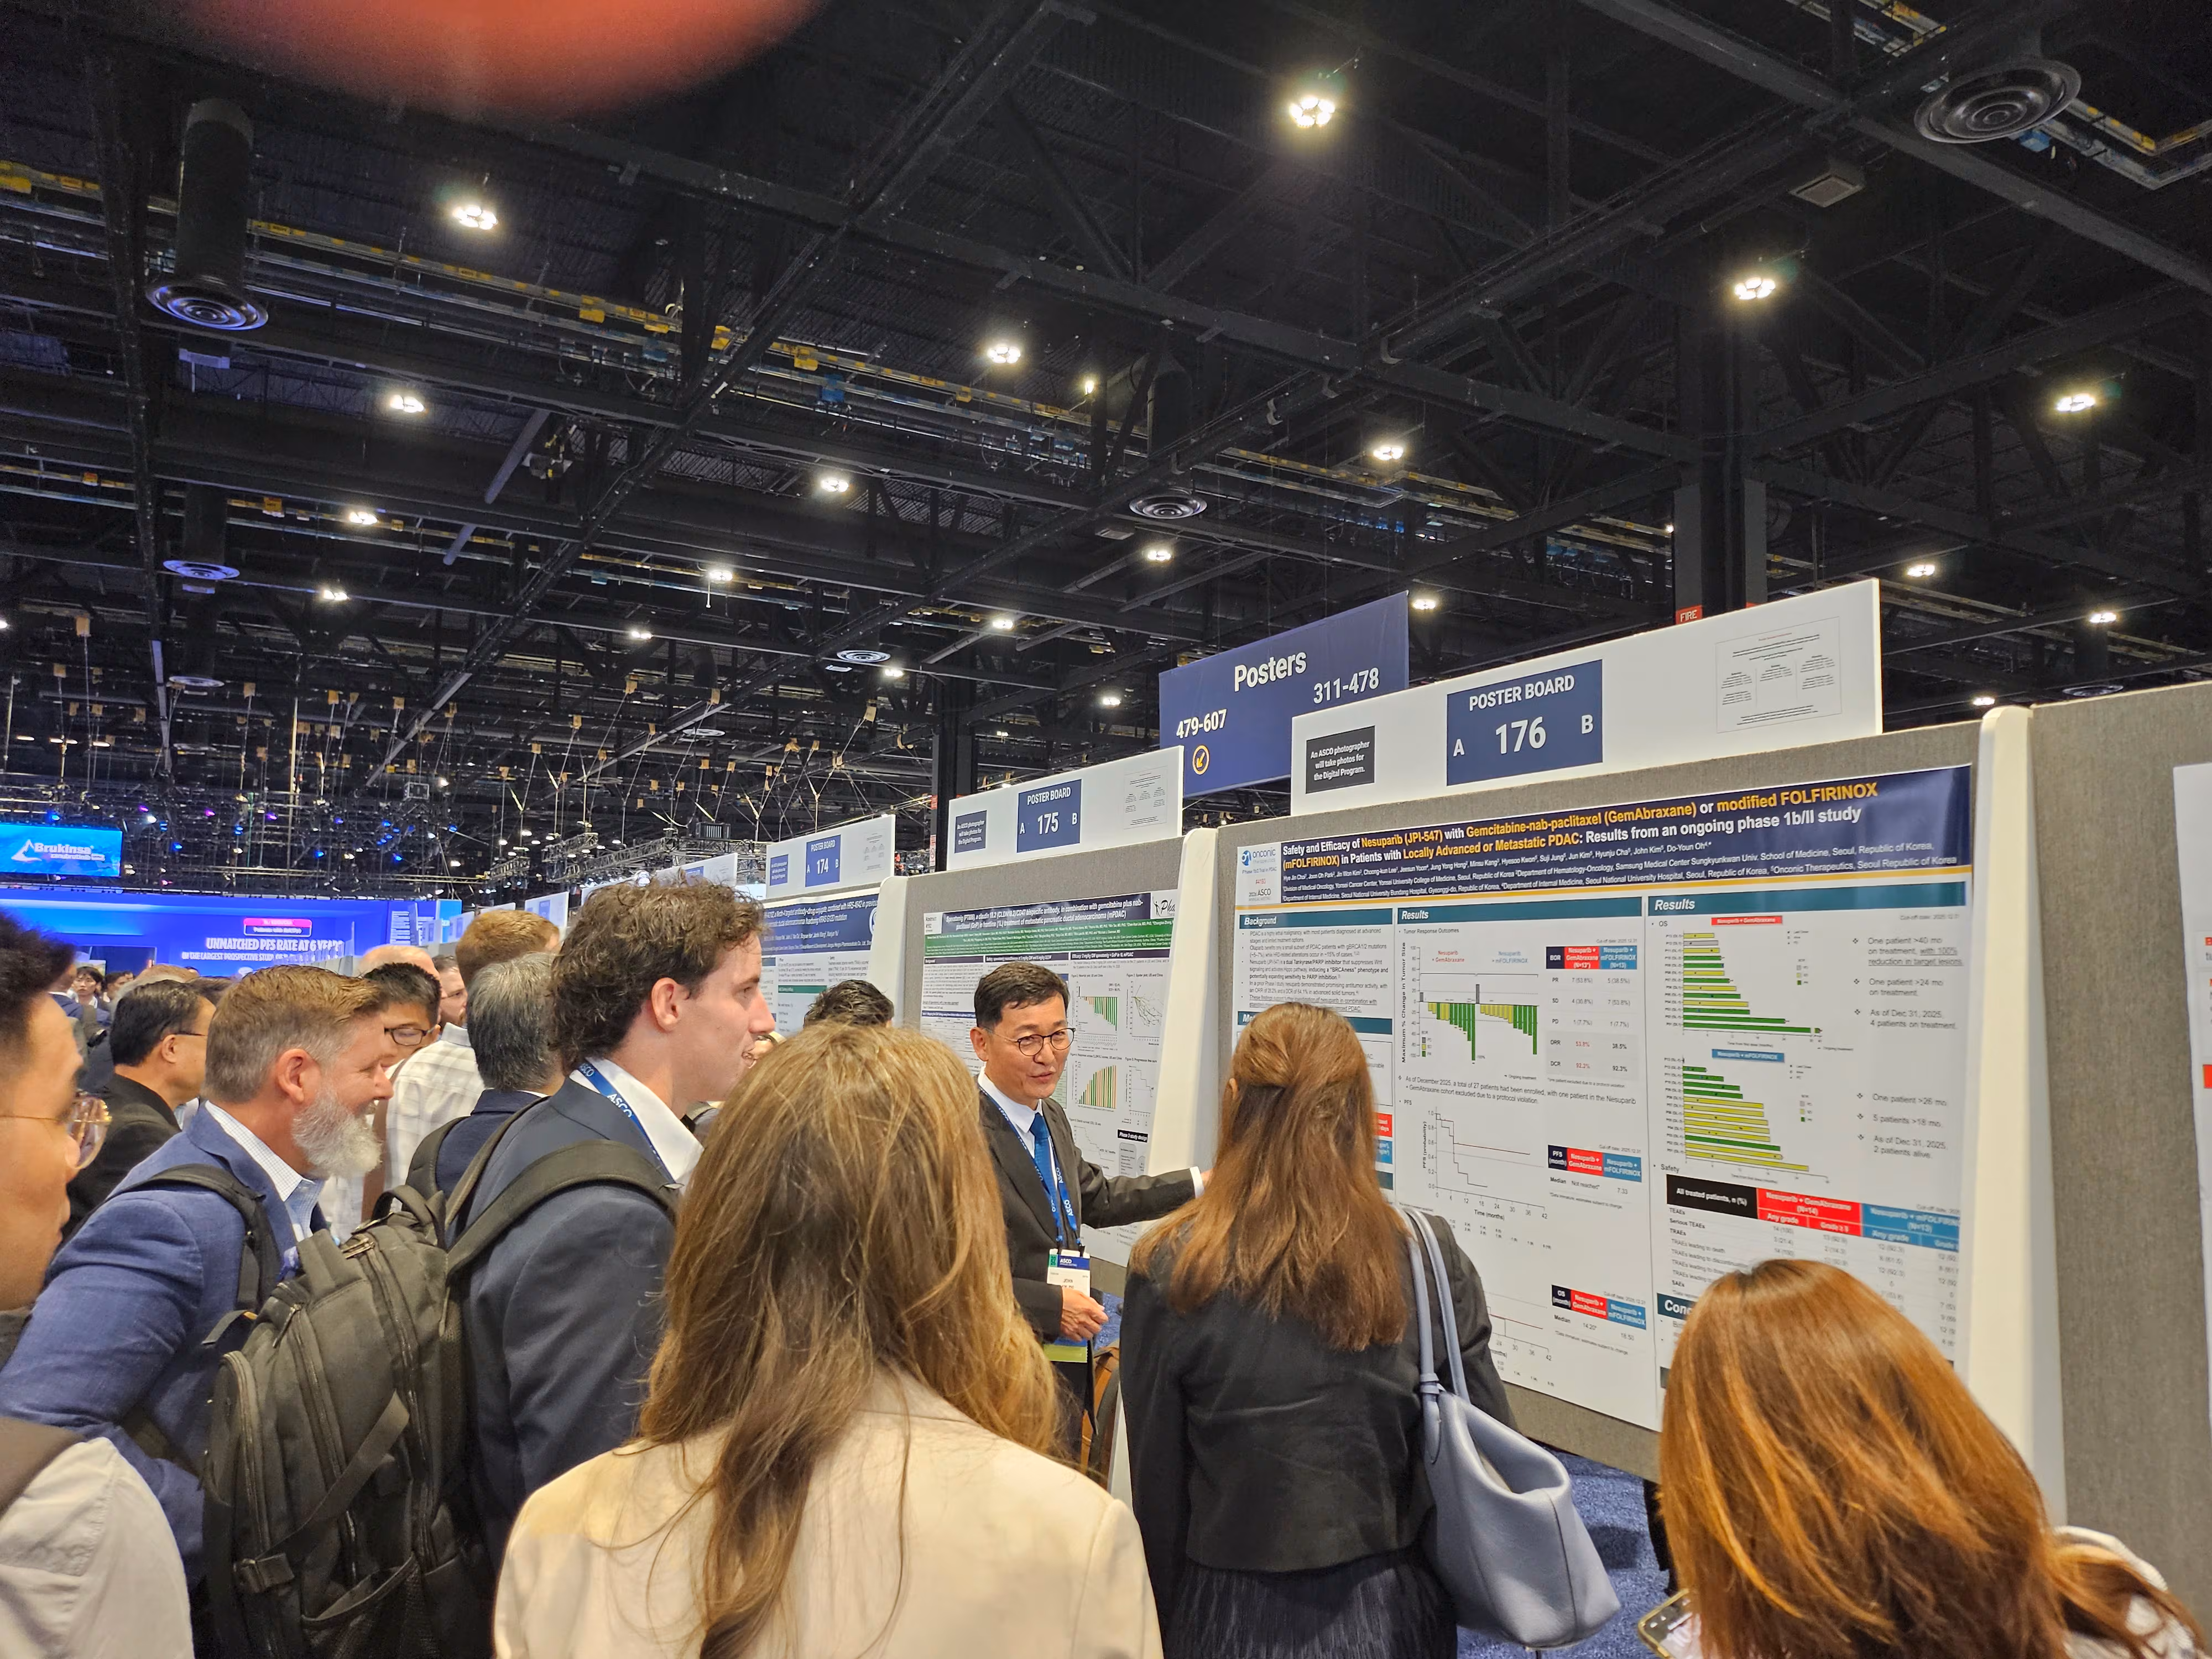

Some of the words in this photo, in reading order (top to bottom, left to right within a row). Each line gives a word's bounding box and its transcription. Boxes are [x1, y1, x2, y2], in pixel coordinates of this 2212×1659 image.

[1681, 609, 1697, 622] FIRE
[1234, 652, 1306, 692] Posters
[1313, 667, 1379, 703] 311-478
[1470, 686, 1522, 711] POSTER
[1525, 675, 1574, 699] BOARD
[1176, 709, 1227, 739] 479-607
[1453, 739, 1464, 757] A
[1496, 717, 1546, 754] 176
[1582, 714, 1593, 734] B
[1319, 748, 1333, 757] ASCO
[1334, 741, 1370, 755] photographer
[1315, 760, 1324, 769] will
[1337, 756, 1355, 766] photos
[1323, 769, 1339, 780] Digital
[1340, 766, 1365, 776] Program.
[1027, 792, 1050, 805] POSTER
[1051, 787, 1071, 800] BOARD
[1020, 822, 1025, 834] A
[1038, 812, 1059, 834] 175
[1072, 813, 1077, 825] B
[1283, 845, 1305, 856] Safety
[1306, 844, 1319, 853] and
[1321, 840, 1350, 852] Efficacy
[1352, 838, 1360, 848] of
[1361, 834, 1402, 848] Nesuparib
[1405, 830, 1443, 846] (JPI-547)
[1444, 828, 1464, 839] with
[1466, 812, 1601, 838] Gemcitabine-nab-paclitaxel
[1604, 801, 1697, 826] (GemAbraxane)
[1700, 804, 1714, 813] or
[1717, 794, 1776, 812] modified
[1780, 782, 1878, 805] FOLFIRINOX
[811, 843, 823, 852] POSTER
[824, 840, 835, 849] BOARD
[1284, 855, 1339, 871] (mFOLFIRINOX)
[1342, 854, 1348, 864] in
[1350, 852, 1382, 863] Patients
[1384, 849, 1401, 860] with
[1404, 847, 1434, 859] Locally
[1436, 842, 1480, 856] Advanced
[1483, 843, 1493, 852] or
[1495, 836, 1546, 851] Metastatic
[1548, 832, 1583, 846] PDAC:
[1586, 829, 1629, 843] Results
[1631, 827, 1659, 839] from
[1662, 827, 1677, 836] an
[1681, 819, 1734, 836] ongoing
[1738, 816, 1780, 833] phase
[1818, 806, 1861, 823] study
[1253, 849, 1276, 858] onconic
[807, 864, 810, 873] A
[817, 858, 828, 874] 174
[836, 859, 838, 868] B
[1655, 899, 1695, 910] Results
[1244, 917, 1276, 927] Background
[1402, 910, 1428, 920] Results
[206, 938, 259, 950] UNMATCHED
[260, 939, 276, 951] PFS
[277, 939, 298, 951] RATE
[299, 940, 309, 951] AT
[310, 941, 316, 951] 6
[1496, 1093, 1515, 1102] protocol
[1524, 1087, 1546, 1095] enrolled,
[1570, 1092, 1588, 1100] patient
[1606, 1095, 1636, 1104] Nesuparib
[1661, 1164, 1679, 1173] Safety
[1064, 1199, 1073, 1216] ASCO
